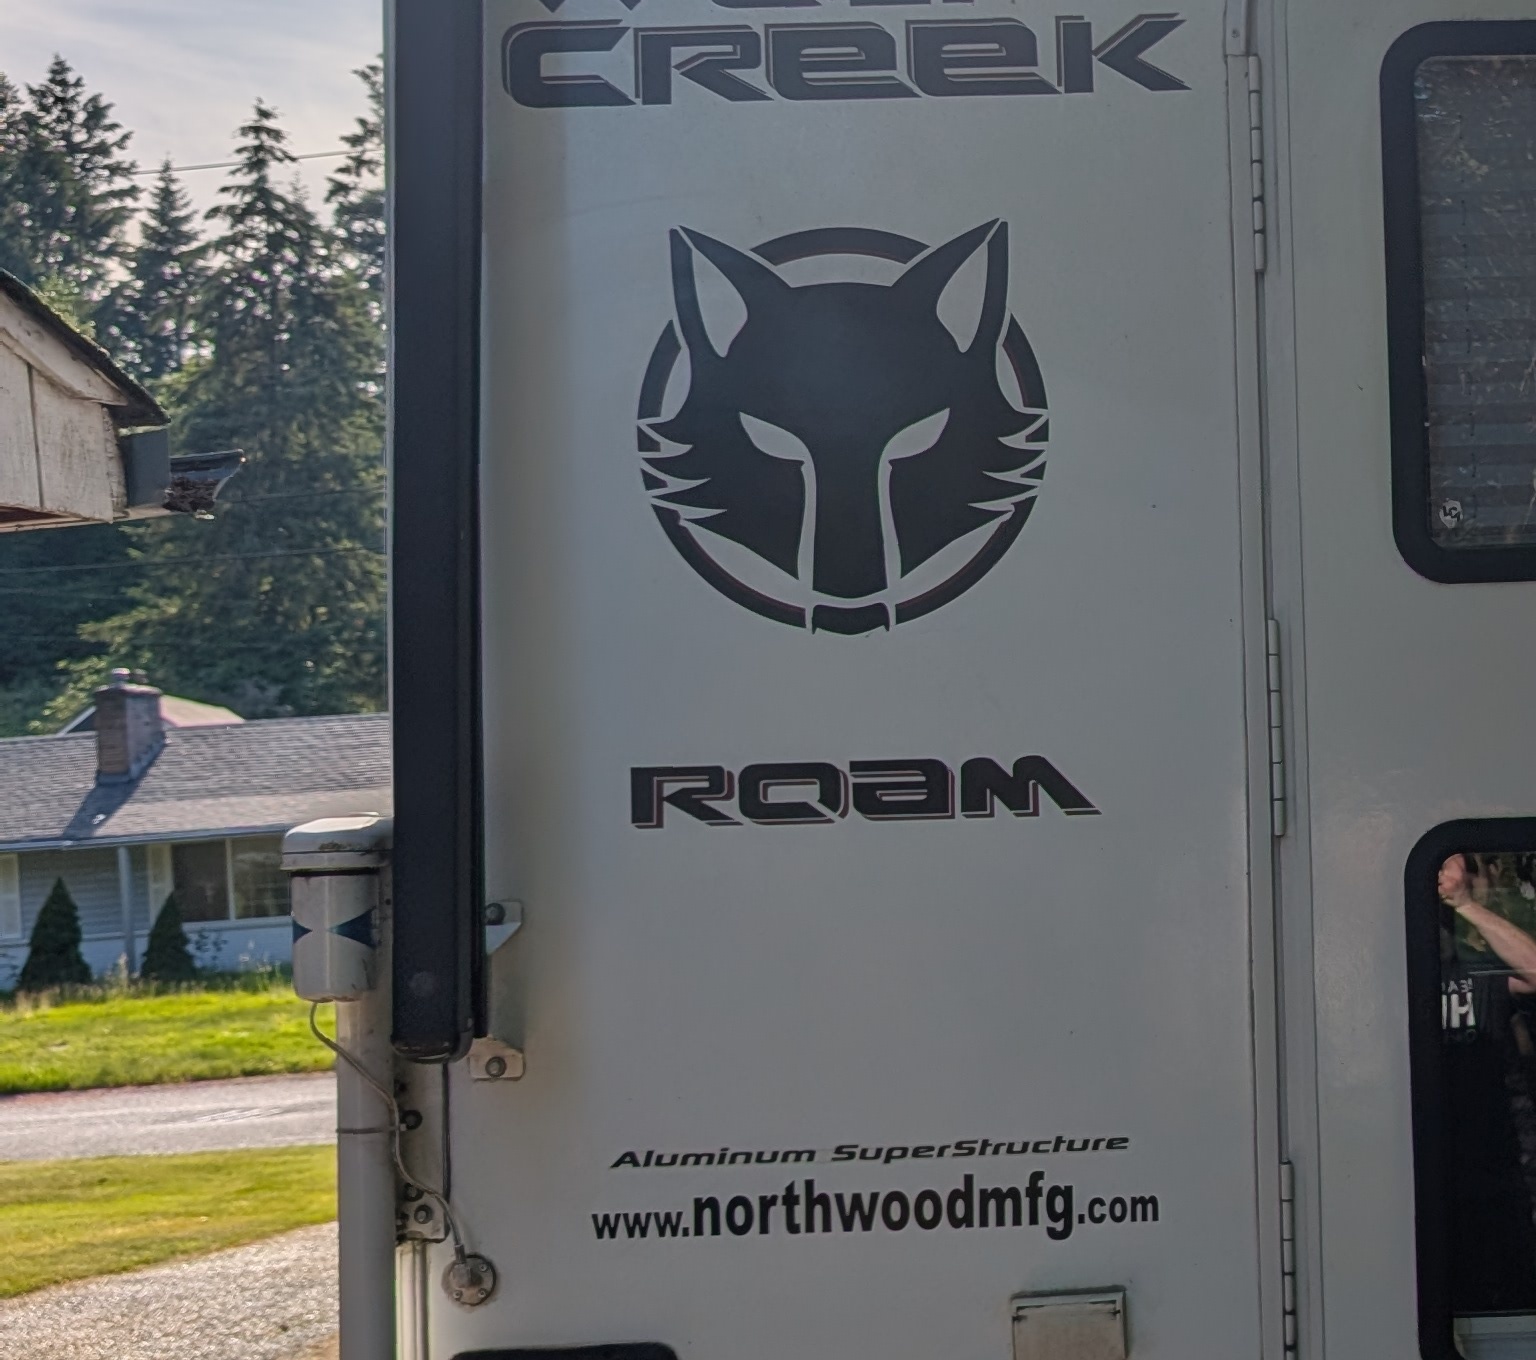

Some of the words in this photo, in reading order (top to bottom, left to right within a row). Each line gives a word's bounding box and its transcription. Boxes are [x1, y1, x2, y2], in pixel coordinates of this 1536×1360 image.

[610, 1146, 816, 1169] Aluminum
[830, 1135, 1131, 1165] SuperStructure
[591, 1171, 1160, 1241] www.northwoodmfg.com
